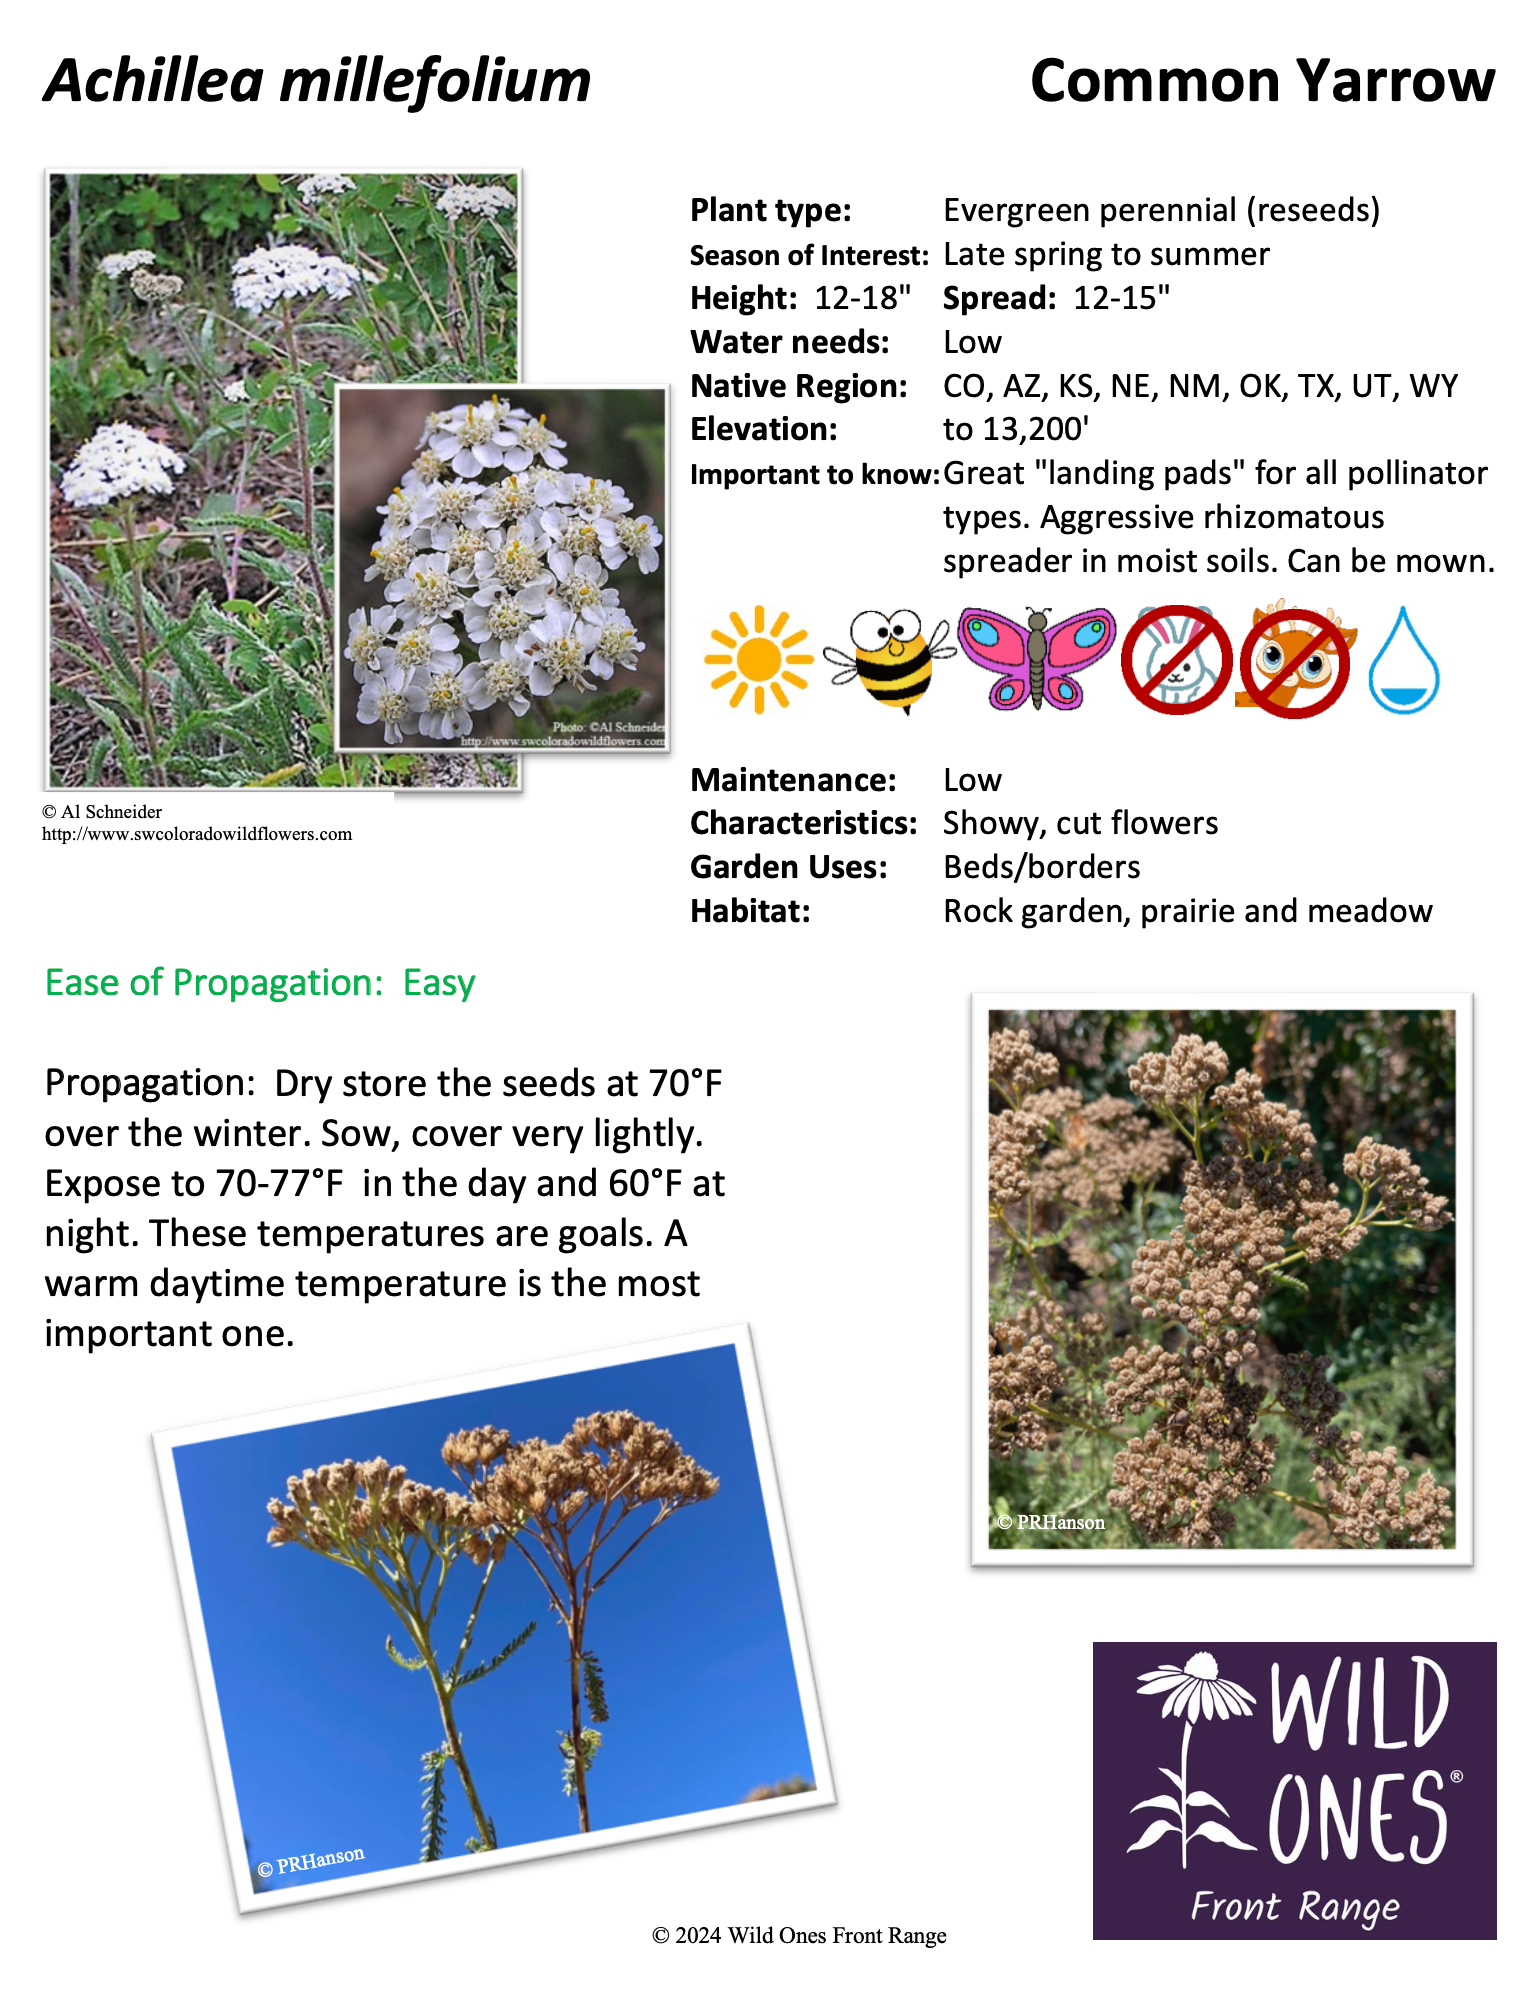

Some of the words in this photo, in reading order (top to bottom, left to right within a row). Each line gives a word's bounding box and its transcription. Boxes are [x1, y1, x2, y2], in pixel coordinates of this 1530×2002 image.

[42, 55, 263, 102] Achillea
[280, 55, 590, 113] millefolium
[1032, 58, 1278, 102] Common
[1296, 58, 1496, 102] Yarrow
[692, 196, 767, 222] Plant
[775, 200, 850, 227] type:
[946, 198, 1089, 228] Evergreen
[1101, 196, 1235, 227] perennial
[1248, 196, 1379, 227] (reseeds)
[691, 245, 779, 265] Season
[788, 243, 814, 265] of
[822, 245, 928, 265] Interest:
[946, 242, 1004, 265] Late
[1015, 241, 1102, 272] spring
[1111, 244, 1141, 265] to
[1151, 248, 1270, 265] summer
[692, 284, 796, 316] Height:
[817, 284, 910, 309] 12-18"
[944, 284, 1055, 315] Spread:
[1076, 284, 1169, 309] 12-15"
[690, 330, 783, 354] Water
[793, 328, 888, 354] needs:
[946, 330, 1002, 353] Low
[692, 373, 786, 398] Native
[797, 373, 906, 404] Region:
[944, 374, 993, 402] CO,
[1003, 374, 1048, 402] AZ,
[1061, 374, 1100, 402] KS,
[1113, 374, 1158, 402] NE,
[1171, 374, 1229, 402] NM,
[1240, 374, 1288, 402] OK,
[1298, 374, 1341, 402] TX,
[1354, 374, 1399, 402] UT,
[1410, 374, 1458, 397] WY
[692, 415, 836, 441] Elevation:
[943, 419, 973, 440] to
[985, 415, 1088, 445] 13,200'
[692, 464, 820, 490] Important
[827, 465, 853, 484] to
[863, 463, 939, 484] know:
[944, 461, 1024, 484] Great
[1036, 459, 1154, 491] "landing
[1165, 459, 1244, 490] pads"
[1255, 459, 1296, 484] for
[1306, 459, 1336, 484] all
[1349, 459, 1488, 490] pollinator
[943, 507, 1029, 535] types.
[1040, 504, 1193, 535] Aggressive
[1205, 503, 1384, 528] rhizomatous
[944, 547, 1072, 578] spreader
[1083, 548, 1106, 572] in
[1118, 548, 1197, 572] moist
[1207, 547, 1277, 572] soils.
[1288, 549, 1340, 572] Can
[1352, 547, 1385, 572] be
[1397, 555, 1494, 572] mown.
[692, 767, 895, 792] Maintenance:
[946, 768, 1002, 791] Low
[61, 805, 80, 818] Al
[86, 804, 162, 818] Schneider
[691, 809, 916, 835] Characteristics:
[944, 809, 1046, 840] Showy,
[1057, 813, 1101, 834] cut
[1111, 809, 1218, 834] flowers
[42, 826, 352, 844] http://www.swcoloradowildflowers.com
[691, 853, 797, 879] Garden
[810, 855, 886, 879] Uses:
[946, 852, 1140, 883] Beds/borders
[692, 897, 809, 923] Habitat:
[946, 897, 1013, 922] Rock
[1022, 897, 1130, 929] garden,
[1142, 898, 1234, 928] prairie
[1245, 897, 1296, 922] and
[1309, 897, 1433, 922] meadow
[48, 969, 118, 995] Ease
[131, 967, 164, 995] of
[175, 968, 381, 1002] Propagation:
[406, 969, 475, 1002] Easy
[47, 1068, 254, 1103] Propagation:
[277, 1069, 332, 1103] Dry
[343, 1071, 426, 1097] store
[437, 1067, 491, 1097] the
[503, 1067, 595, 1097] seeds
[607, 1071, 638, 1097] at
[650, 1068, 722, 1097] 70°F
[45, 1126, 119, 1147] over
[128, 1117, 182, 1147] the
[194, 1119, 310, 1147] winter.
[322, 1119, 399, 1152] Sow,
[412, 1126, 502, 1147] cover
[512, 1126, 583, 1153] very
[596, 1117, 702, 1153] lightly.
[47, 1169, 160, 1203] Expose
[171, 1171, 204, 1196] to
[217, 1168, 343, 1197] 70-77°F
[364, 1169, 391, 1196] in
[402, 1167, 457, 1197] the
[469, 1167, 526, 1203] day
[537, 1167, 596, 1197] and
[610, 1168, 681, 1197] 60°F
[693, 1171, 725, 1197] at
[47, 1217, 138, 1253] night.
[149, 1217, 246, 1247] These
[257, 1221, 484, 1253] temperatures
[496, 1226, 548, 1247] are
[559, 1217, 652, 1253] goals.
[664, 1219, 687, 1246] A
[45, 1276, 137, 1296] warm
[151, 1267, 284, 1303] daytime
[295, 1271, 506, 1303] temperature
[519, 1269, 541, 1297] is
[551, 1267, 606, 1297] the
[619, 1271, 700, 1297] most
[46, 1319, 212, 1353] important
[222, 1326, 293, 1347] one.
[1271, 1656, 1449, 1751] WILD
[1192, 1891, 1281, 1920] Front
[1299, 1891, 1400, 1931] Range
[676, 1927, 721, 1943] 2024
[728, 1926, 774, 1943] Wild
[780, 1927, 826, 1943] Ones
[833, 1927, 882, 1943] Front
[888, 1927, 946, 1948] Range
